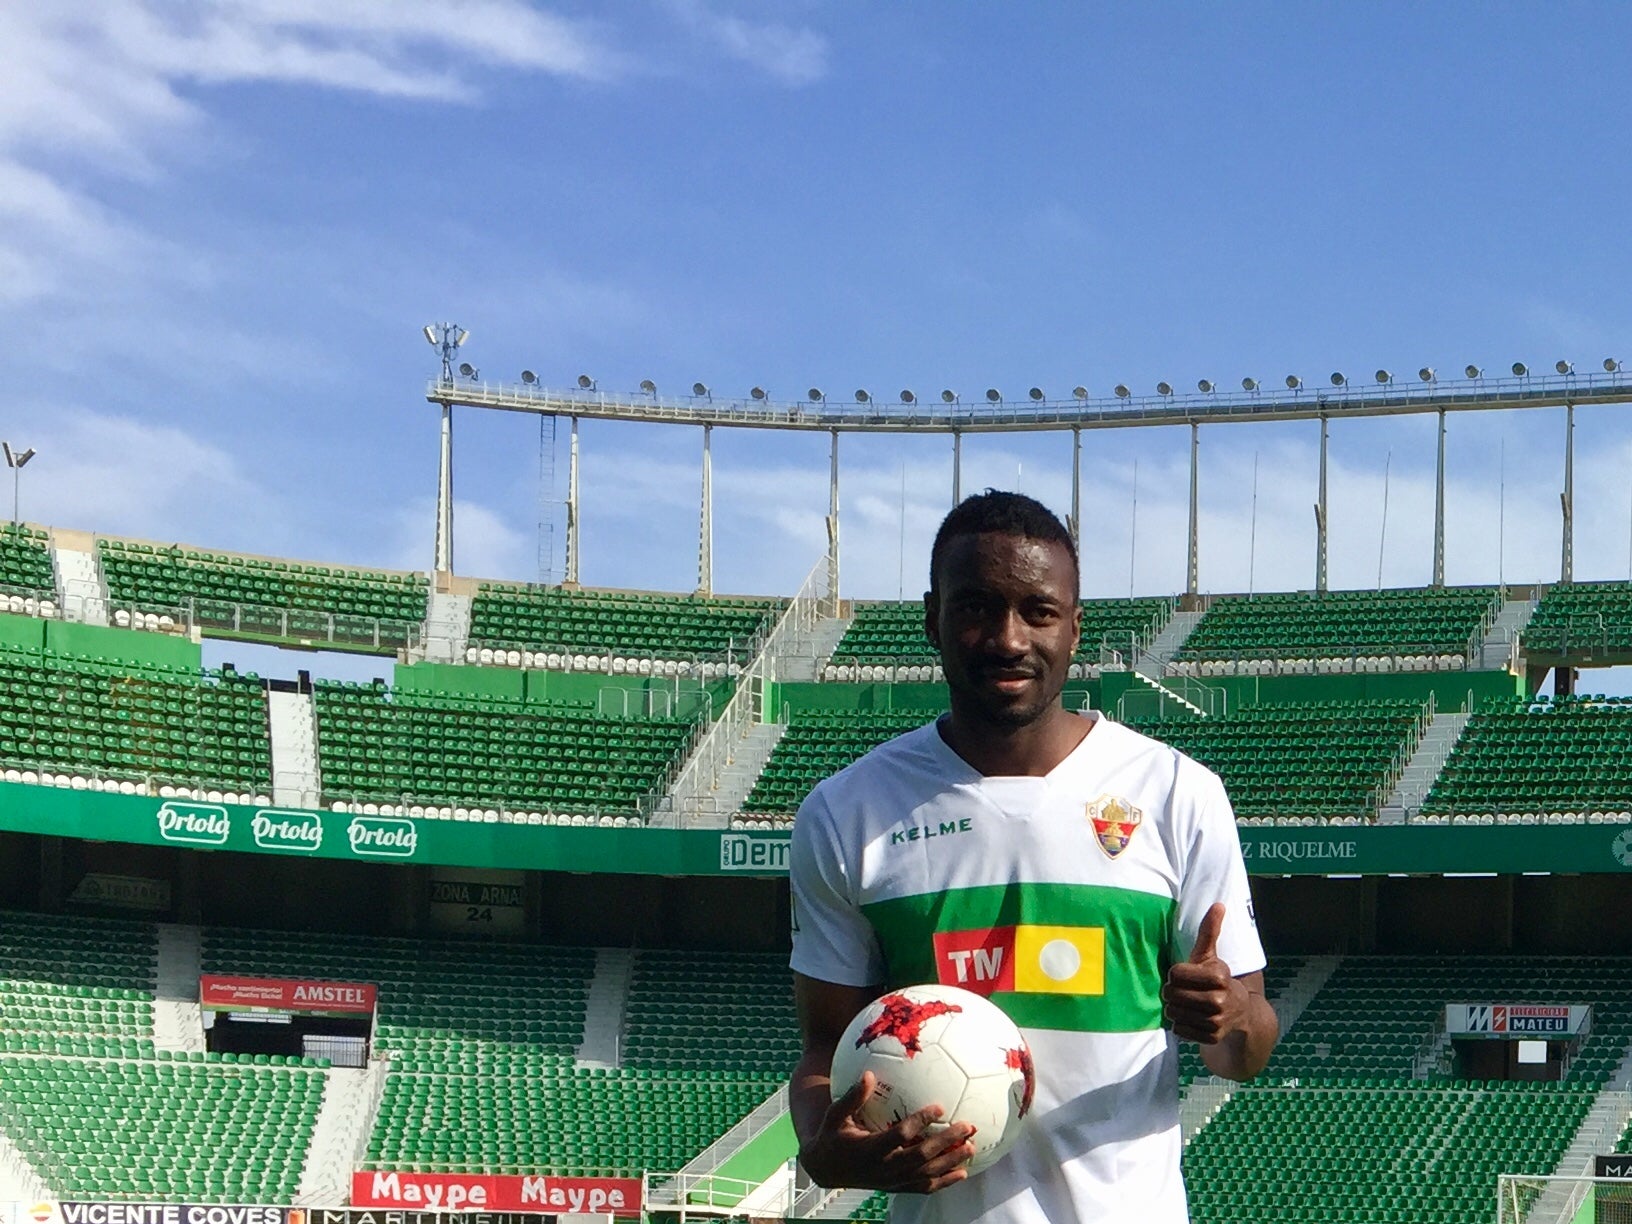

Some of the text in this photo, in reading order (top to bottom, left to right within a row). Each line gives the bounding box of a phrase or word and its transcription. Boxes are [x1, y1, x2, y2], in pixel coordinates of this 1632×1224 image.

[892, 818, 973, 845] KELME
[1259, 842, 1357, 862] RIQUELME
[466, 907, 493, 922] 24
[948, 946, 1004, 983] TM
[293, 986, 365, 1003] AMSTEL
[1513, 1018, 1564, 1031] MATEU
[371, 1172, 625, 1214] Maype Maype
[62, 1204, 180, 1224] VICENTE
